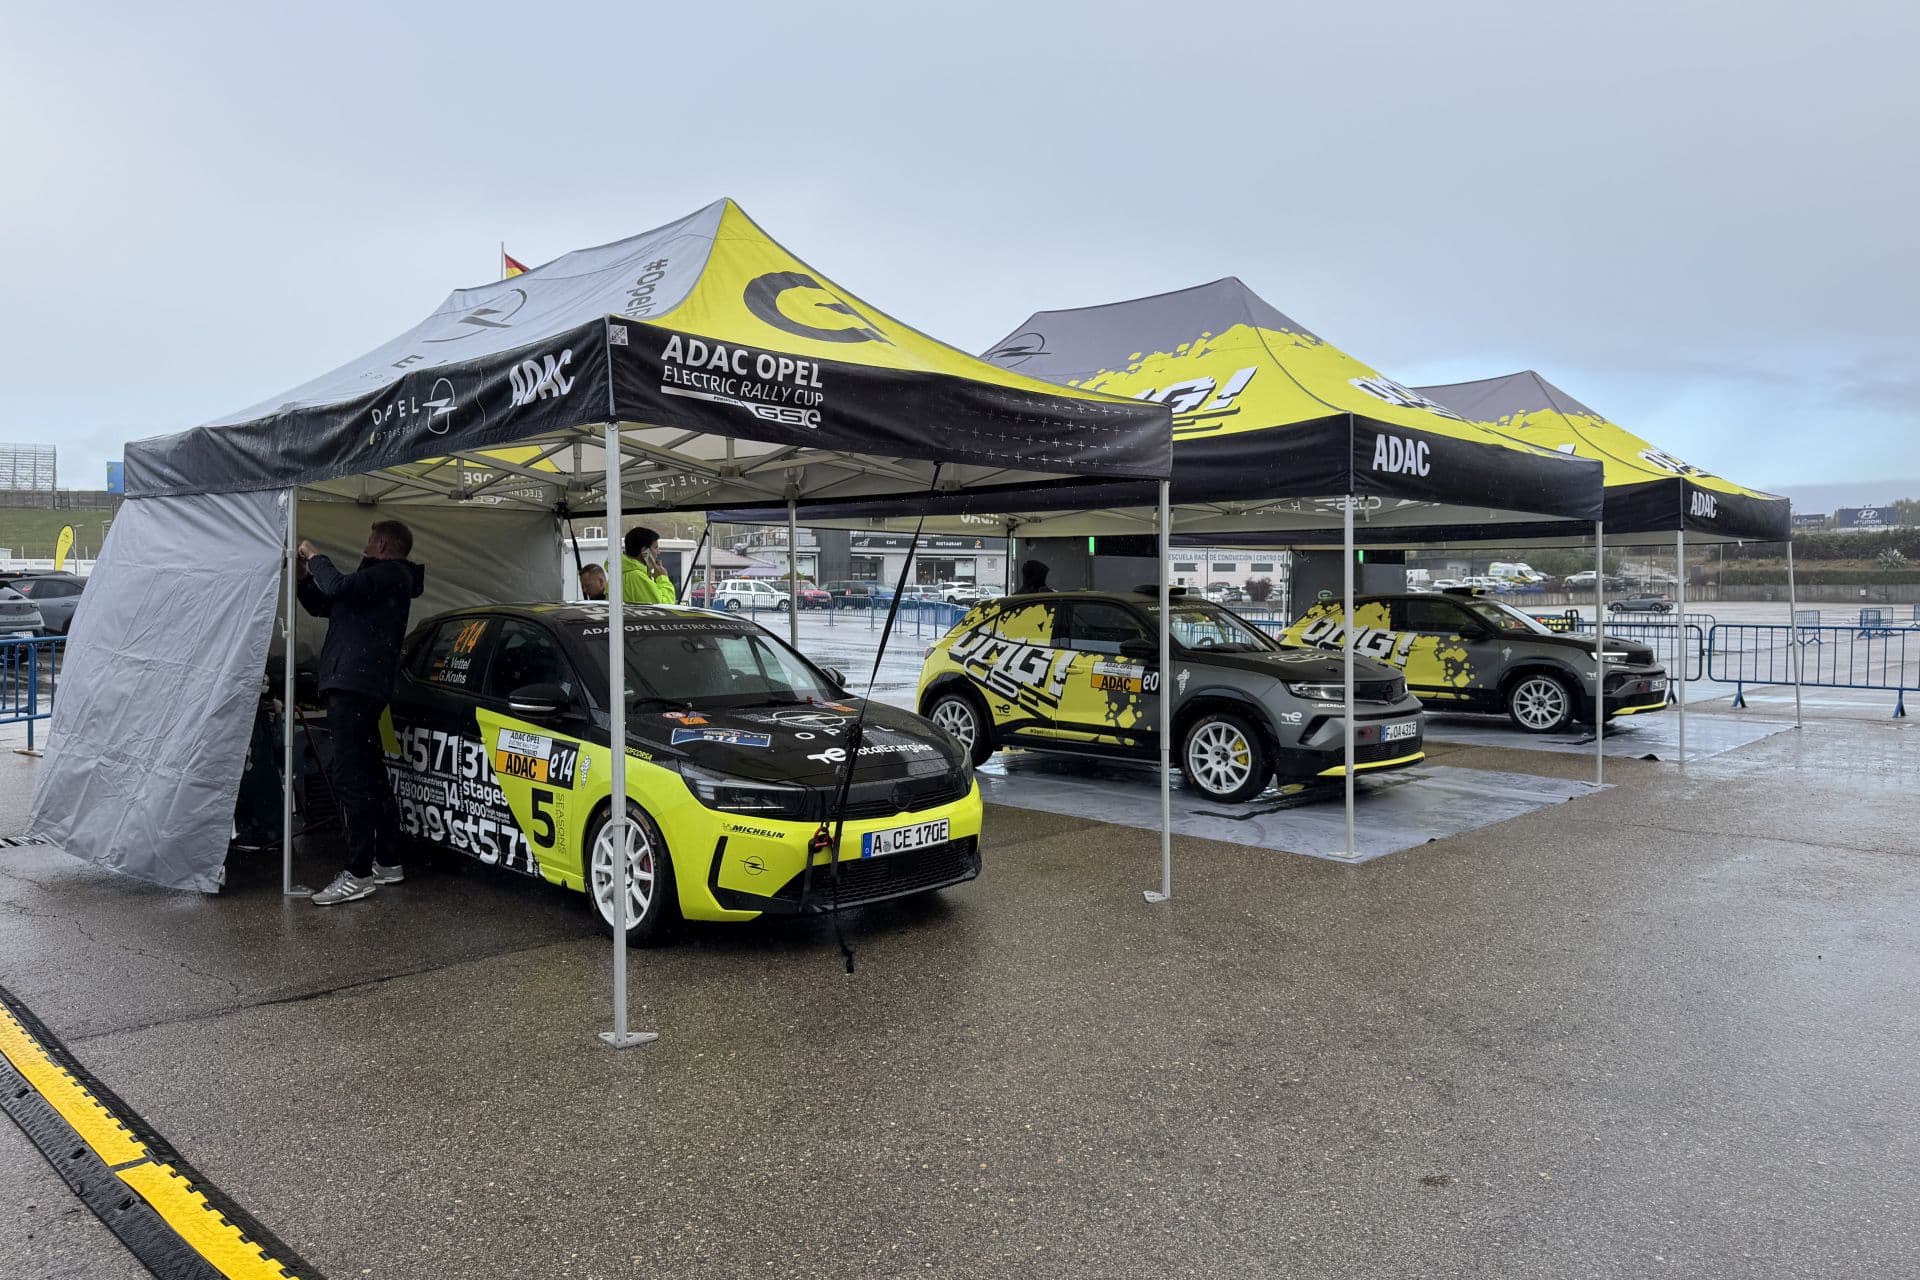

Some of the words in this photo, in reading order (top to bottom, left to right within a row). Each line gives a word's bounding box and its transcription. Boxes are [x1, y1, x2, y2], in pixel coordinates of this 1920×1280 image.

[660, 334, 748, 376] ADAC
[756, 353, 824, 389] OPEL
[508, 348, 575, 409] ADAC
[662, 364, 737, 396] ELECTRIC
[739, 380, 792, 404] RALLY
[793, 389, 824, 408] CUP
[370, 395, 420, 426] OPEL
[1372, 433, 1431, 478] ADAC
[1690, 490, 1718, 519] ADAC
[1168, 553, 1193, 561] ESCUELA
[1255, 553, 1277, 561] CENTRO
[453, 620, 487, 654] e14
[582, 627, 610, 636] ADA
[624, 624, 660, 632] OPEL
[660, 624, 711, 632] ELECTRIC
[450, 657, 472, 671] Vettel
[1101, 675, 1132, 691] ADAC
[1142, 671, 1160, 692] e0
[510, 731, 526, 743] ADAC
[794, 725, 896, 740] OPL
[852, 742, 934, 756] otalEnergies
[505, 753, 538, 779] ADAC
[548, 748, 577, 782] e14
[462, 778, 510, 807] stages
[531, 787, 556, 849] 5
[731, 824, 785, 839] MICHELIN
[872, 835, 883, 855] A
[893, 829, 912, 849] CE
[915, 821, 948, 846] 170E
